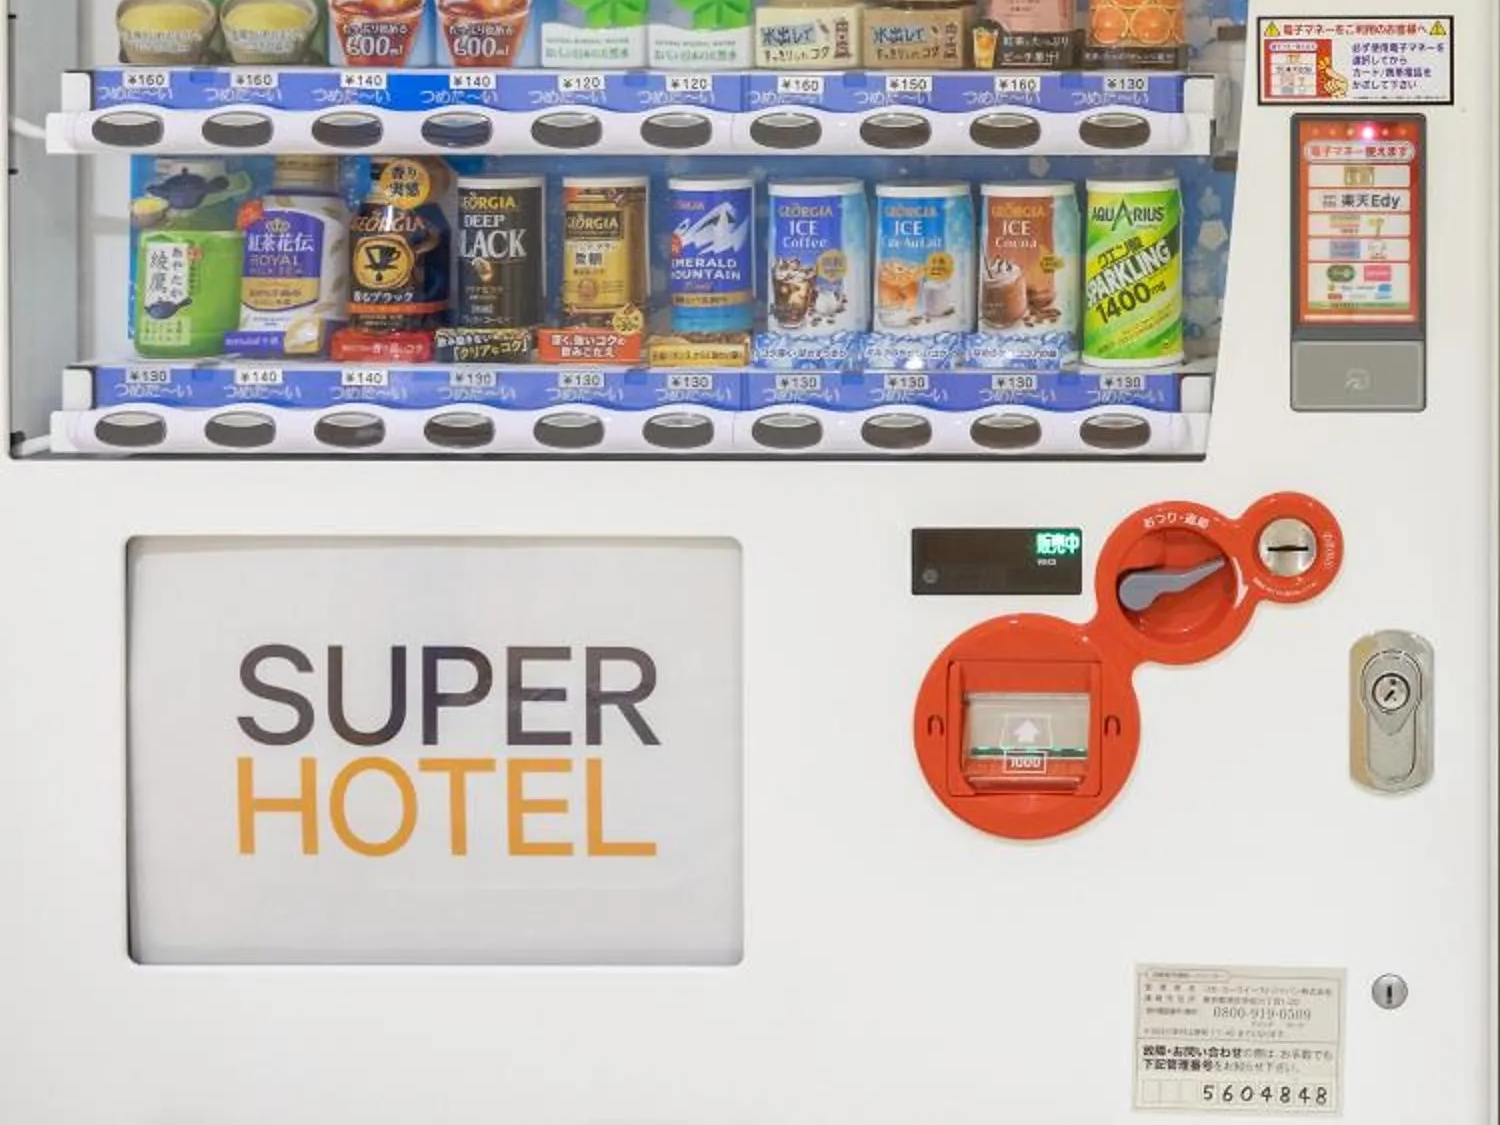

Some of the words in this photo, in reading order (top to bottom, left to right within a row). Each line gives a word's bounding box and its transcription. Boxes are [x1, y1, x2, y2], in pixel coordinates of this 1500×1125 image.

[789, 220, 820, 236] ICE
[894, 220, 923, 236] ICE
[1002, 219, 1032, 236] ICE
[460, 229, 528, 259] LACK
[782, 237, 828, 249] Coffee
[236, 643, 661, 747] SUPER
[1009, 756, 1042, 770] 1000
[237, 755, 657, 857] HOTEL
